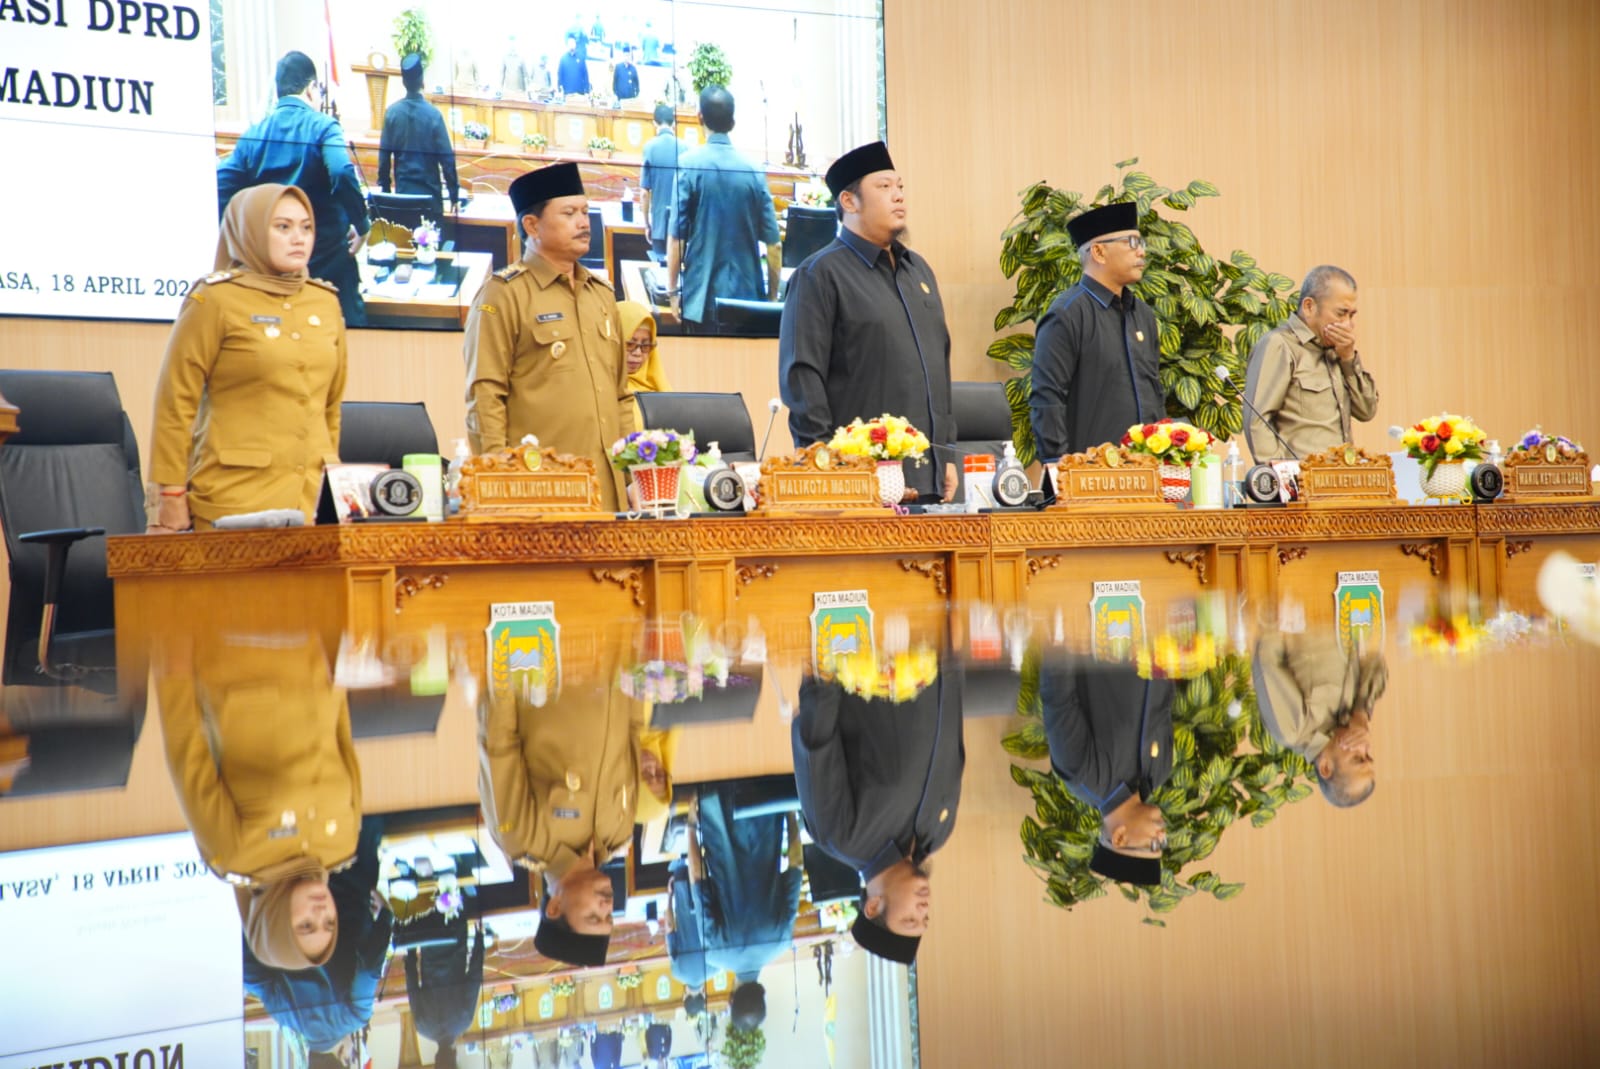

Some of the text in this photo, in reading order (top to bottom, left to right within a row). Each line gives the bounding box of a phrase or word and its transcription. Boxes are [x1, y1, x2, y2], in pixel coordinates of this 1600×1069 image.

[87, 0, 200, 41] DPRD
[0, 67, 154, 115] MADIUN
[52, 273, 75, 292] 18
[84, 275, 146, 295] APRIL
[154, 278, 194, 297] 202
[778, 479, 869, 496] WALIKOTA MADIUN
[1079, 476, 1147, 491] KETUA DPRD
[1339, 572, 1378, 583] KOTA MADIUN
[1096, 582, 1140, 593] KOTA MADIUN
[817, 591, 867, 605] KOTA MADIUN
[493, 603, 553, 617] KOTA MADIUN
